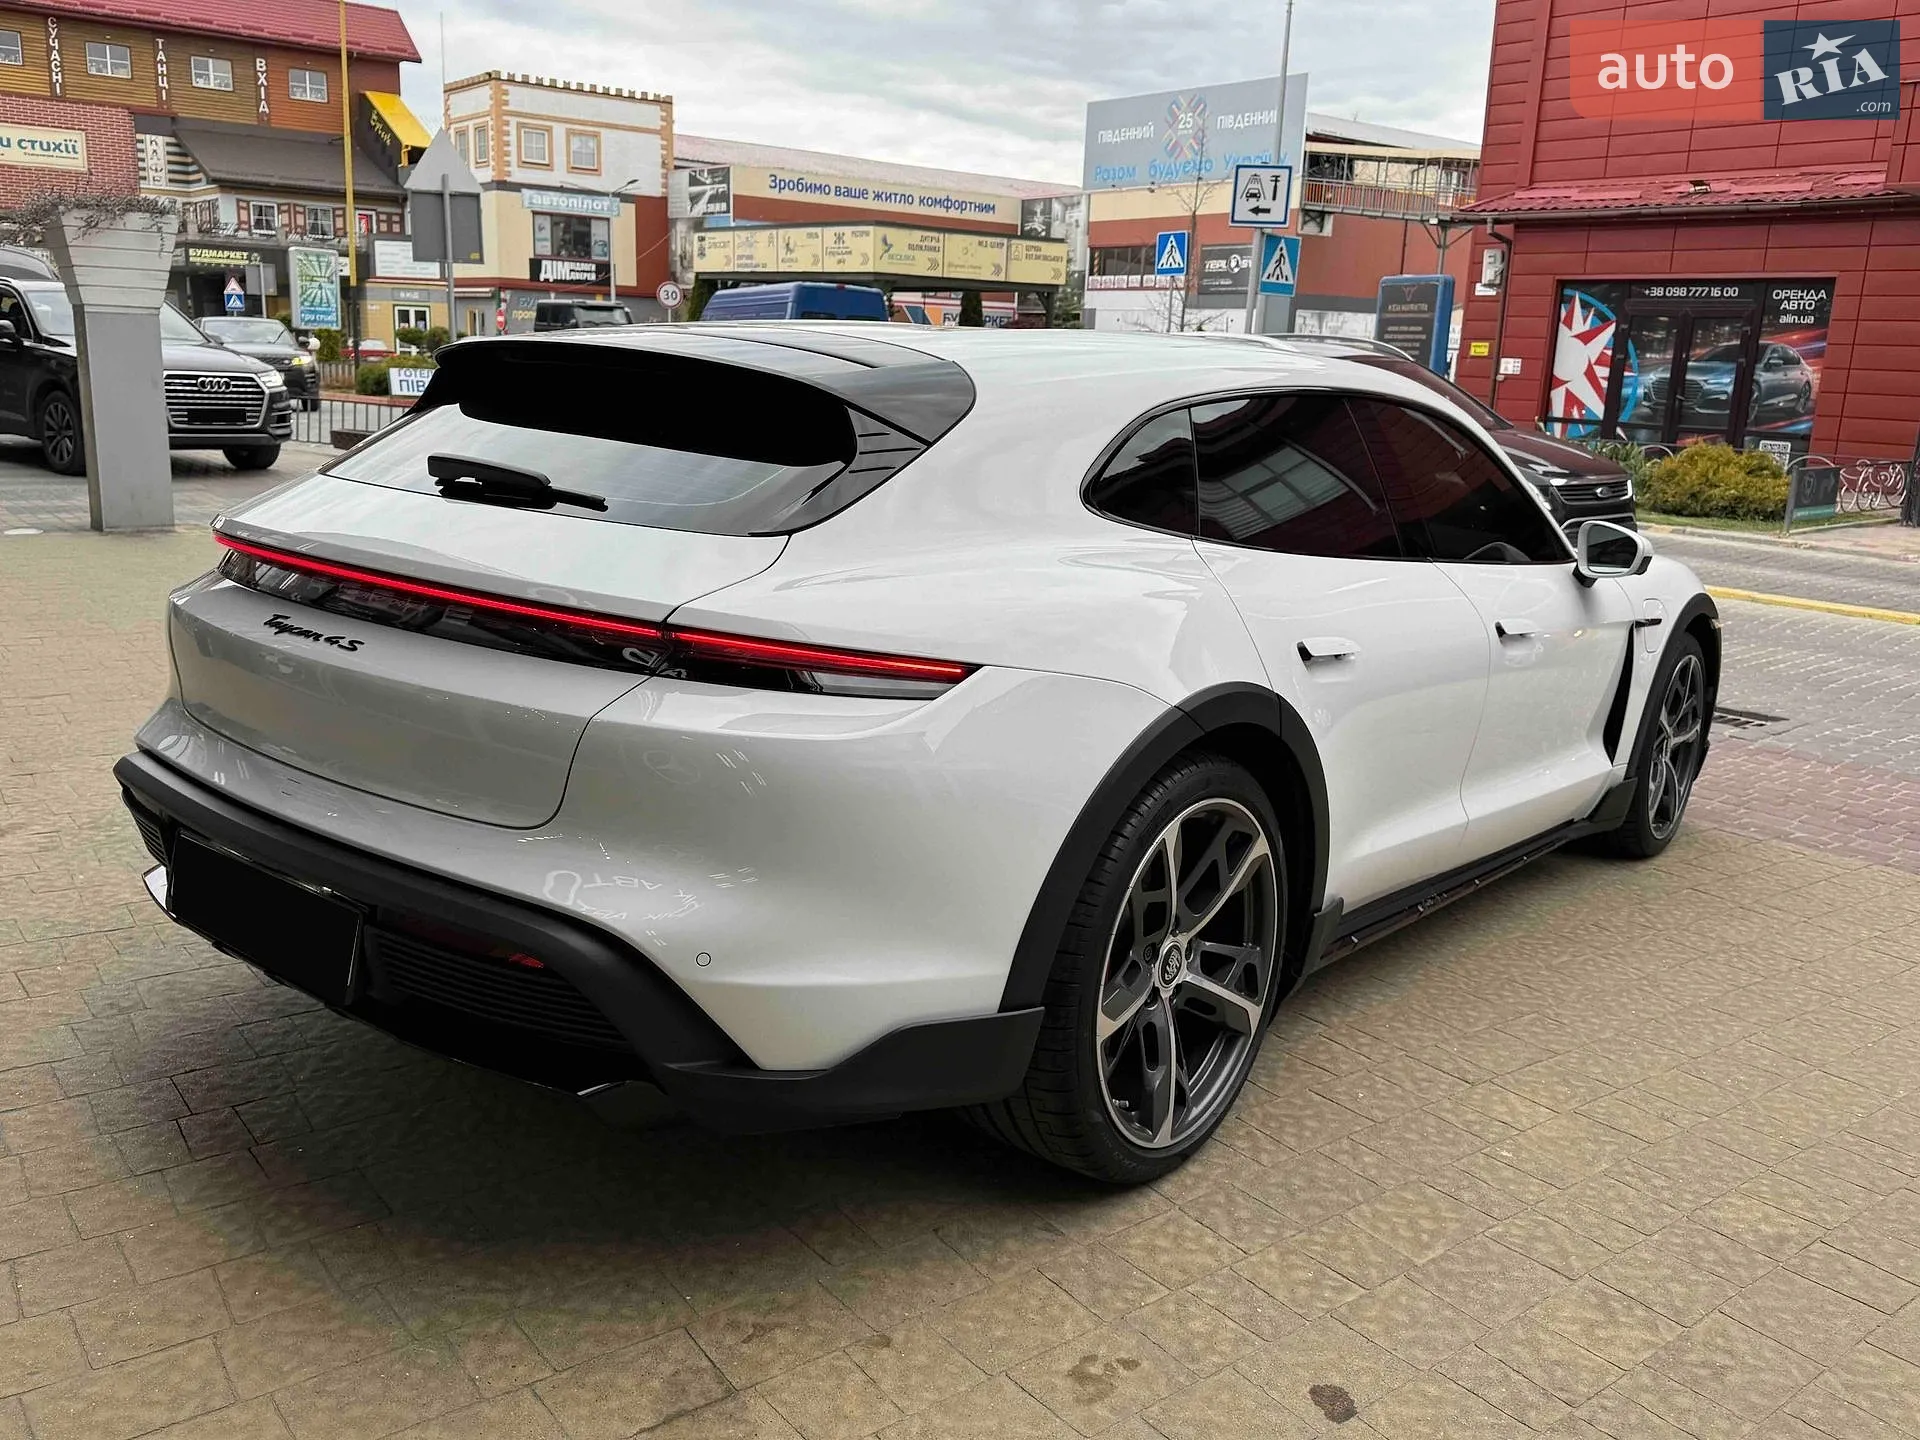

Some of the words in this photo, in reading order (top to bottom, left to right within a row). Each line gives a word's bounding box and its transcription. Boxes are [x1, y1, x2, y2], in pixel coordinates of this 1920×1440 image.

[48, 17, 62, 94] СУЧАСНІ
[156, 38, 169, 101] ТАНЦІ
[1178, 112, 1194, 129] 25
[1098, 122, 1154, 145] ПІВДЕННИЙ
[17, 138, 79, 154] стихії
[1094, 164, 1137, 182] Разом
[1149, 158, 1214, 180] будуємо
[532, 193, 610, 211] автопілот
[769, 174, 831, 197] Зробимо
[834, 185, 869, 199] ваше
[872, 188, 914, 205] житло
[918, 195, 996, 214] комфортним
[189, 247, 249, 260] БУДМАРКЕТ
[540, 259, 570, 282] ДІМ
[663, 290, 678, 300] 30
[1644, 286, 1664, 297] +38
[1665, 286, 1687, 297] 098
[1689, 286, 1709, 297] 777
[1710, 286, 1721, 297] 16
[1723, 286, 1739, 297] 00
[1772, 289, 1827, 300] ОРЕНДА
[1780, 299, 1816, 311] АВТО
[1779, 313, 1815, 324] alin.ua
[400, 379, 425, 392] ПІВ
[264, 614, 324, 642] Taycan
